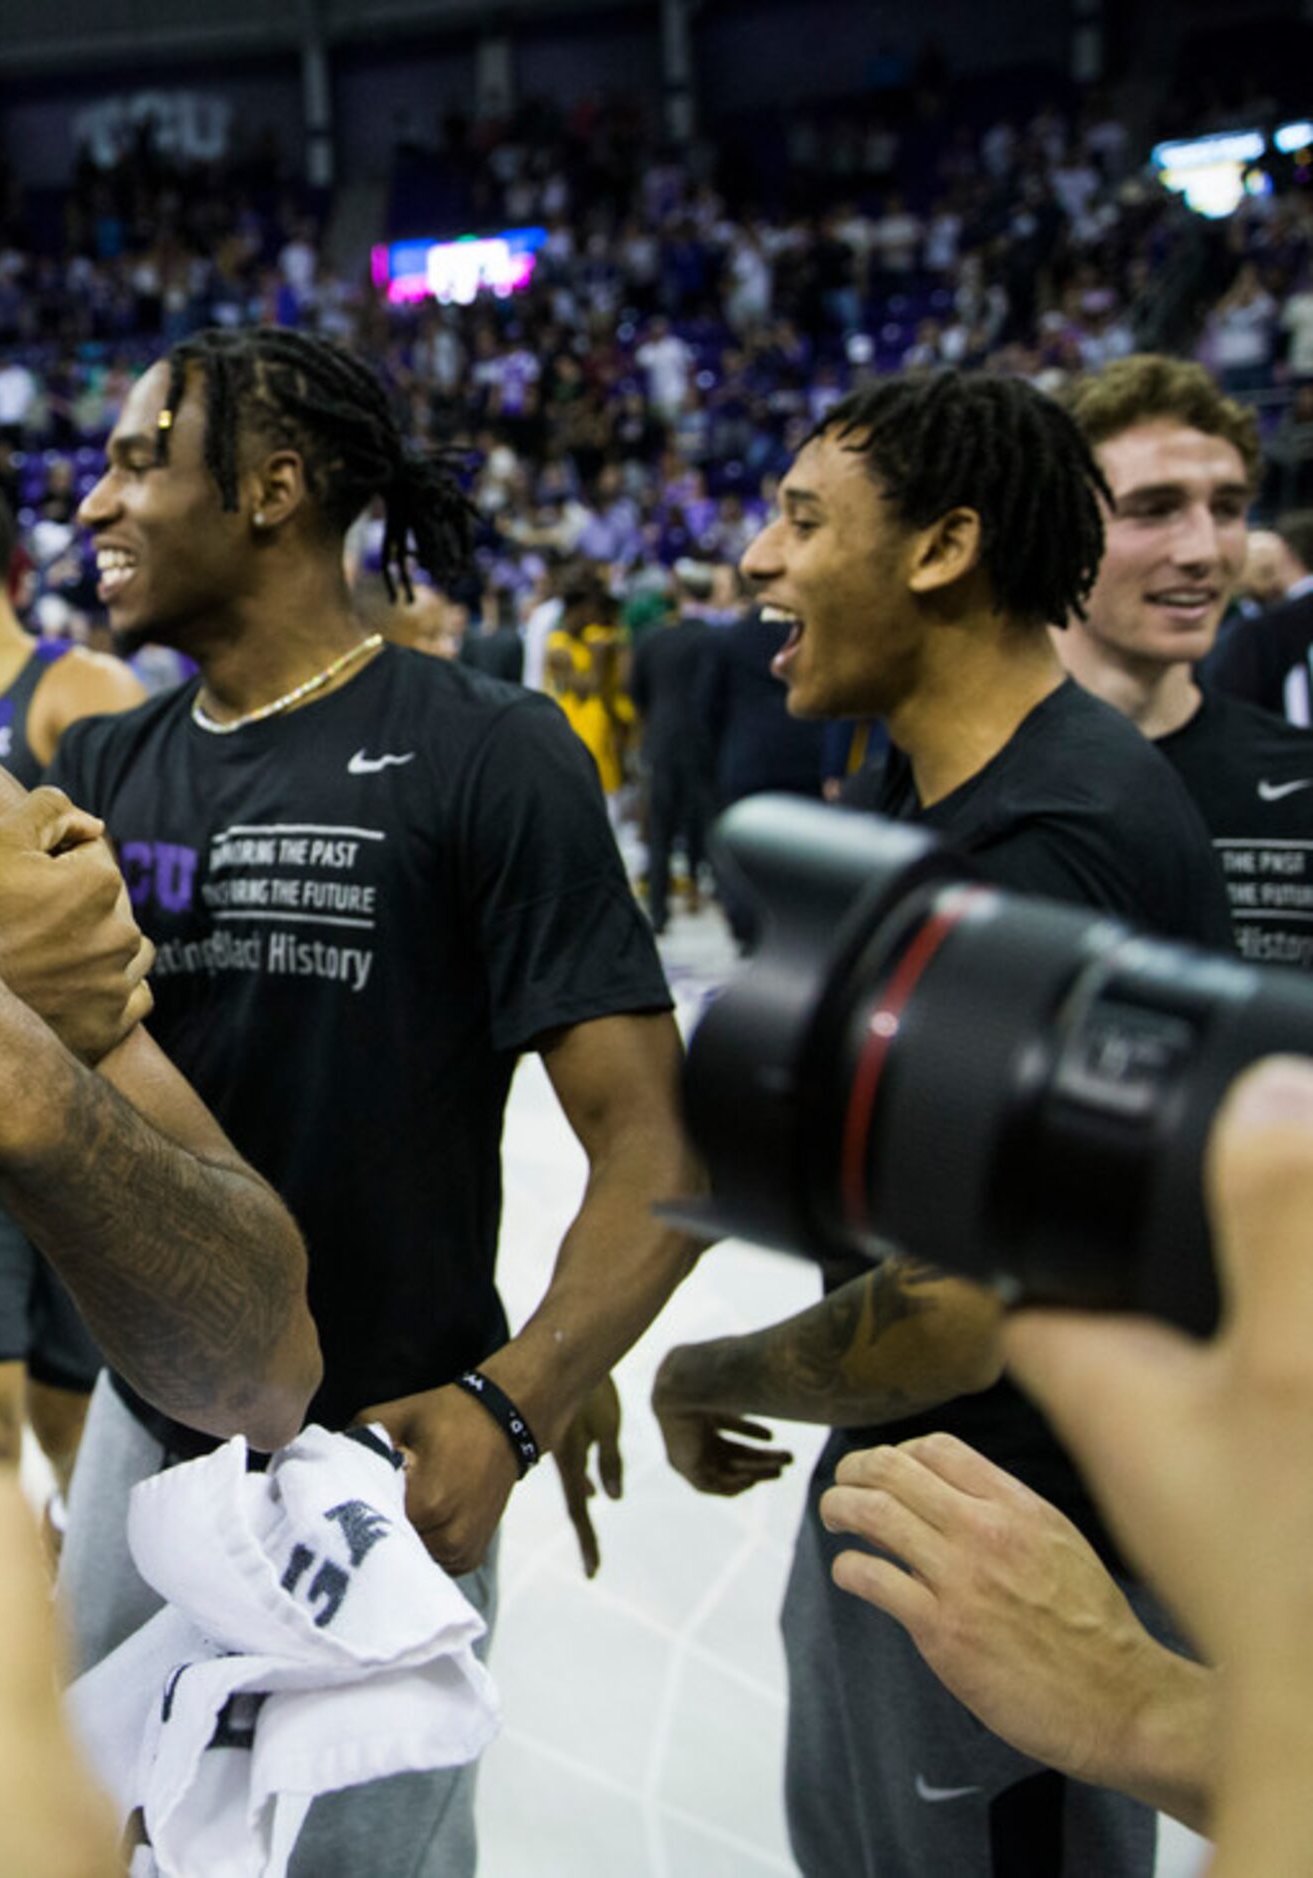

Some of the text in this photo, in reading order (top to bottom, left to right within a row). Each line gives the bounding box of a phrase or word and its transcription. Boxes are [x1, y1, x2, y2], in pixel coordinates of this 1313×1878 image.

[279, 838, 309, 867] THE
[309, 839, 360, 868] PAST
[122, 841, 198, 913] CU
[271, 879, 301, 907] THE
[301, 880, 376, 912] FUTURE
[268, 931, 374, 991] History
